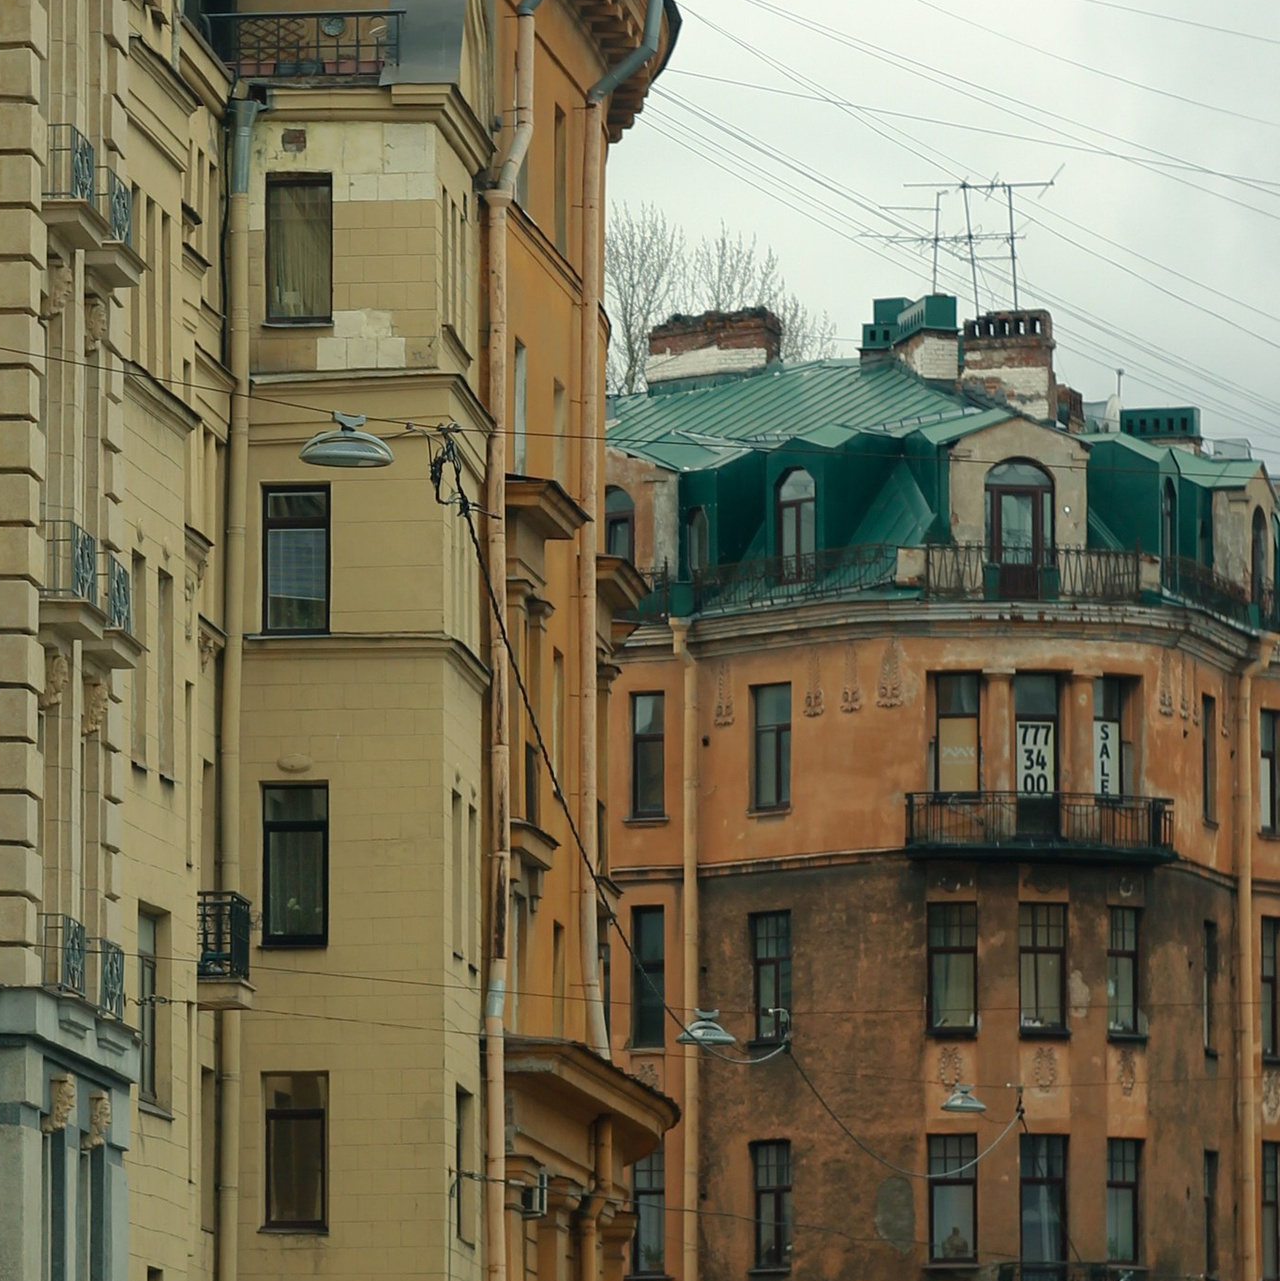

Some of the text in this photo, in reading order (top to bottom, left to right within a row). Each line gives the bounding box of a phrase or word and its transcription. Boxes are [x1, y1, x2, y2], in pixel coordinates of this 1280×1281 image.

[1018, 723, 1052, 747] 777
[1023, 748, 1048, 771] 34
[1099, 723, 1110, 795] SALE
[1023, 773, 1048, 795] 00
